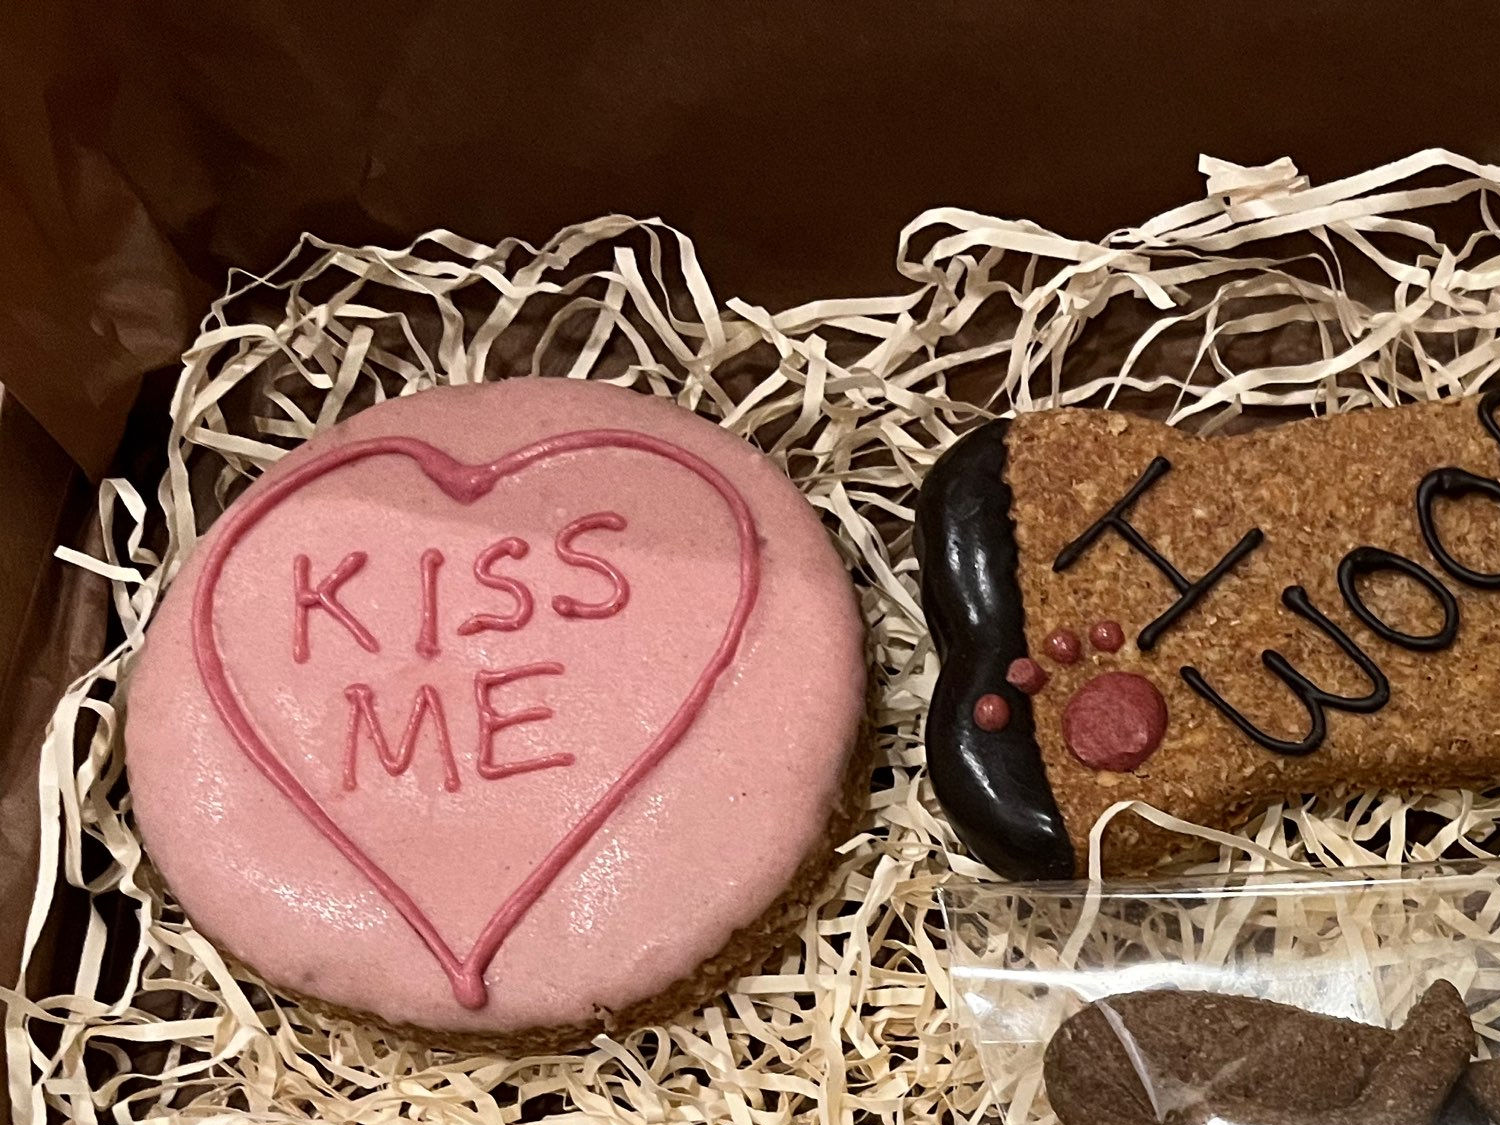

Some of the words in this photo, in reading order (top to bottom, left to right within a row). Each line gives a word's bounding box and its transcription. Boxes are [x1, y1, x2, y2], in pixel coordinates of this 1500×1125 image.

[293, 511, 631, 663] KISS
[1052, 457, 1264, 651] I
[343, 661, 575, 793] ME
